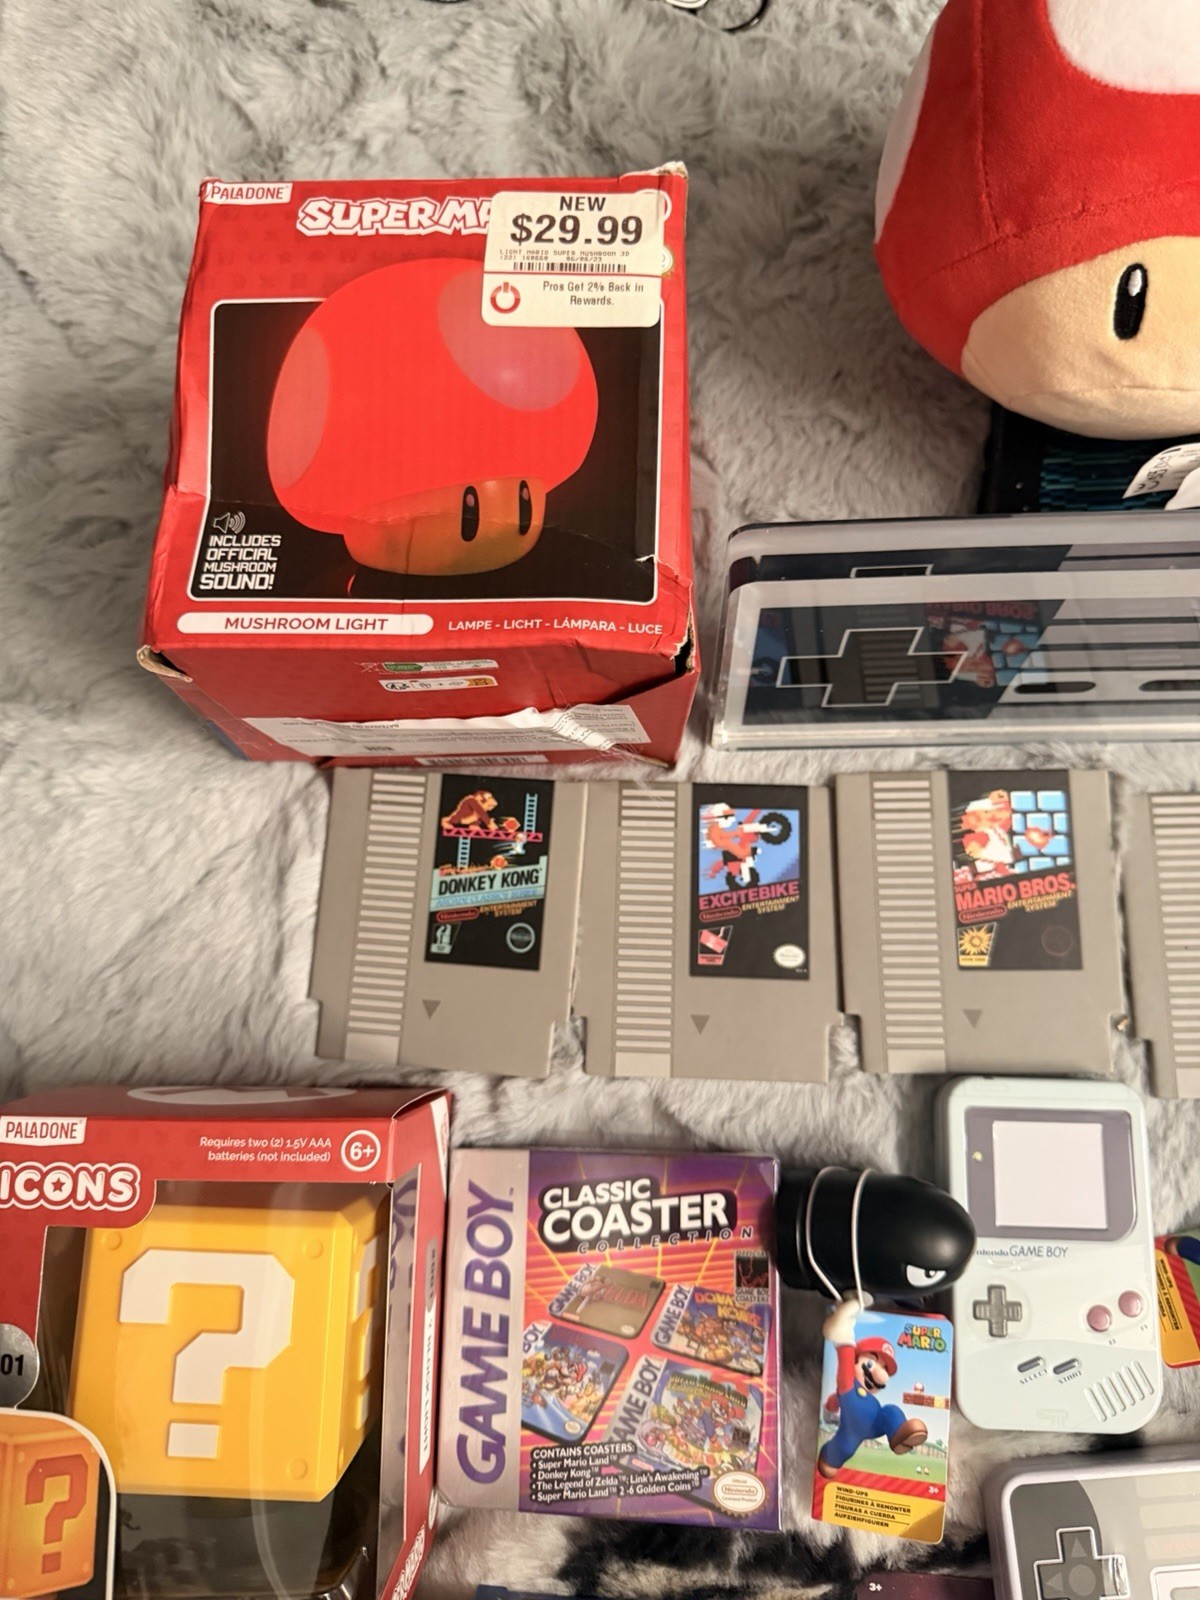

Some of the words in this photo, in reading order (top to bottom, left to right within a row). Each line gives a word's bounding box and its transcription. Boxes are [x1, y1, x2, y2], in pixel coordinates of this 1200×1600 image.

[211, 185, 284, 200] PALADONE
[559, 195, 606, 212] NEW
[298, 197, 438, 236] SUPER
[510, 213, 643, 246] $29.99
[543, 281, 564, 291] Pros
[567, 282, 584, 292] Get
[587, 282, 605, 292] 2%
[608, 282, 630, 292] Back
[570, 295, 614, 306] Rewards.
[208, 534, 282, 547] INCLUDES
[206, 547, 278, 561] OFFICIAL
[203, 562, 277, 573] MUSHROOM
[199, 573, 275, 590] SOUND!
[224, 617, 330, 631] MUSHROOM
[335, 618, 388, 631] LIGHT
[448, 619, 493, 631] LAMPE
[503, 618, 543, 630] LICHT
[553, 616, 617, 632] LÁMPARA
[628, 623, 663, 634] LUCE
[438, 873, 497, 896] DONKEY
[501, 868, 540, 888] KONG
[698, 880, 799, 911] EXCITEBIKE
[955, 883, 1017, 911] MARIO
[1018, 872, 1076, 899] BROS.
[479, 900, 537, 914] ENTERTAINMENT
[742, 895, 800, 911] ENTERTAINMENT
[1007, 890, 1072, 910] ENTERTAINMENT
[1025, 901, 1057, 913] SYSTEM
[494, 908, 523, 918] SYSTEM
[757, 904, 785, 915] SYSTEM
[5, 1121, 78, 1139] PALADONE
[200, 1136, 246, 1149] Requires
[248, 1137, 268, 1148] two
[270, 1137, 284, 1148] (2)
[286, 1138, 308, 1149] 1.5V
[308, 1138, 332, 1148] AAA
[350, 1141, 375, 1160] 6+
[208, 1151, 255, 1161] batteries
[257, 1151, 279, 1161] (not
[281, 1151, 331, 1162] included)
[0, 1167, 136, 1204] ICONS
[543, 1178, 652, 1210] CLASSIC
[543, 1192, 730, 1244] COASTER
[463, 1178, 514, 1301] BOY
[577, 1225, 754, 1255] COLLECTION
[1009, 1245, 1044, 1257] GAME
[1046, 1246, 1068, 1258] BOY
[548, 1281, 582, 1313] GAME
[574, 1263, 597, 1283] BOY
[654, 1308, 681, 1344] GAME
[670, 1284, 691, 1309] BOY
[904, 1323, 942, 1339] SUPER
[897, 1333, 947, 1353] MARIO
[457, 1305, 510, 1485] GAME
[608, 1393, 647, 1443] AME
[633, 1357, 661, 1398] BOY
[532, 1446, 582, 1459] CONTAINS
[583, 1443, 634, 1456] COASTERS:
[538, 1460, 562, 1471] Super
[563, 1458, 587, 1468] Mario
[537, 1470, 568, 1481] Donkey
[537, 1481, 553, 1491] The
[554, 1479, 584, 1491] Legend
[585, 1477, 594, 1487] of
[630, 1474, 653, 1484] Link's
[537, 1492, 562, 1504] Super
[563, 1489, 587, 1499] Mario
[619, 1486, 625, 1496] 2
[636, 1483, 666, 1494] Golden
[724, 1486, 756, 1494] Nintendo
[836, 1486, 869, 1497] WIND-UPS
[928, 1485, 940, 1495] 3+
[834, 1503, 862, 1513] FIGURAS
[869, 1509, 896, 1519] CUERDA
[835, 1495, 869, 1507] FIGURINES
[876, 1503, 911, 1514] REMONTER
[834, 1512, 889, 1527] AUFZIEHFIGUREN
[868, 1582, 883, 1592] 3+
